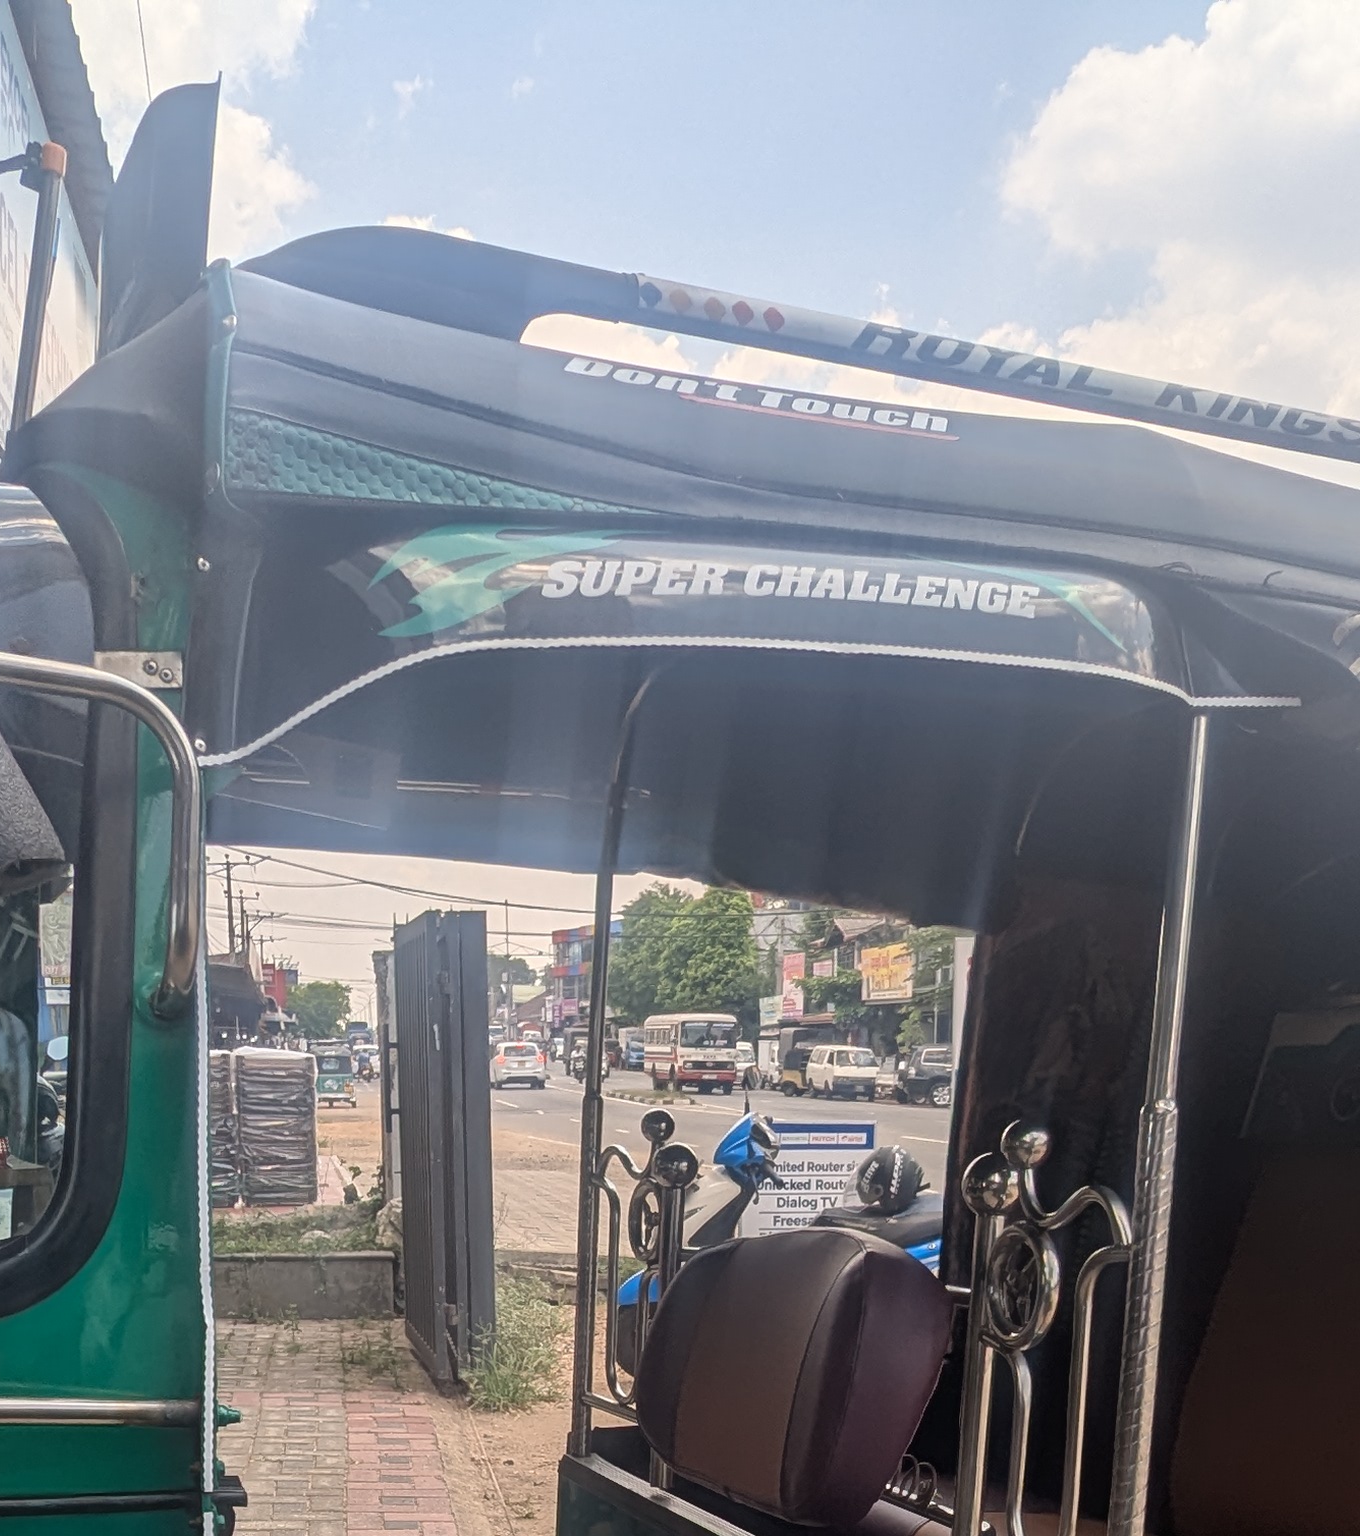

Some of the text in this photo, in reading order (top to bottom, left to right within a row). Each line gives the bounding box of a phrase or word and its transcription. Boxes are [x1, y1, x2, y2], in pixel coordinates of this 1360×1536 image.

[850, 321, 1114, 397] ROYAL
[563, 355, 950, 433] Don't Touch
[541, 559, 1041, 619] SUPER CHALLENGE
[773, 1161, 805, 1173] mited
[807, 1161, 845, 1173] Router
[776, 1196, 838, 1211] Dialog TV
